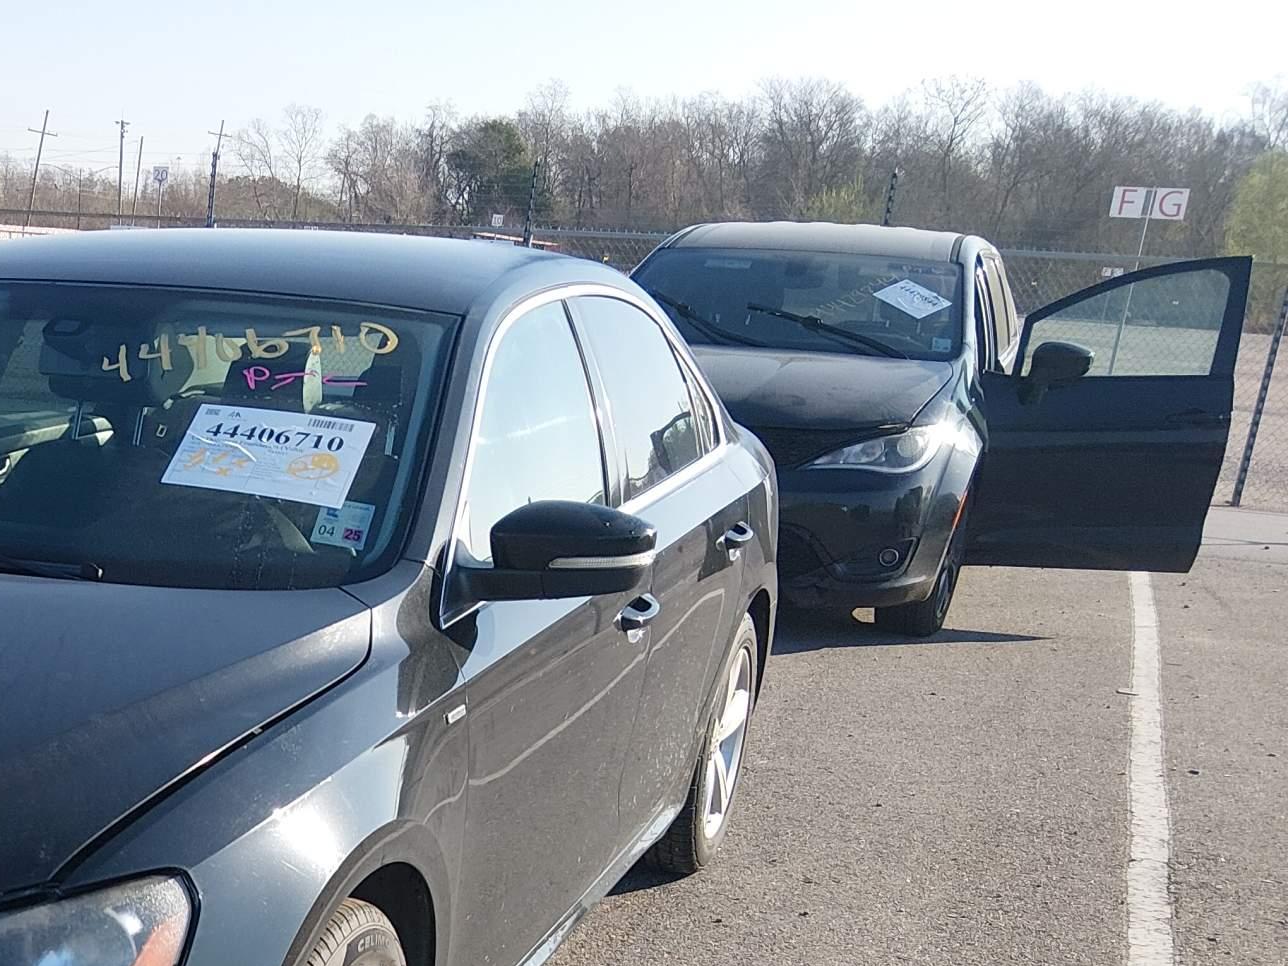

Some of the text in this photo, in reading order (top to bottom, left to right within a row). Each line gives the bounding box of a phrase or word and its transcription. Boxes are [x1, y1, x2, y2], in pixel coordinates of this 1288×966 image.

[153, 168, 169, 181] 20
[1117, 188, 1185, 218] F G
[205, 422, 345, 453] 44406710
[318, 524, 362, 542] 04 25
